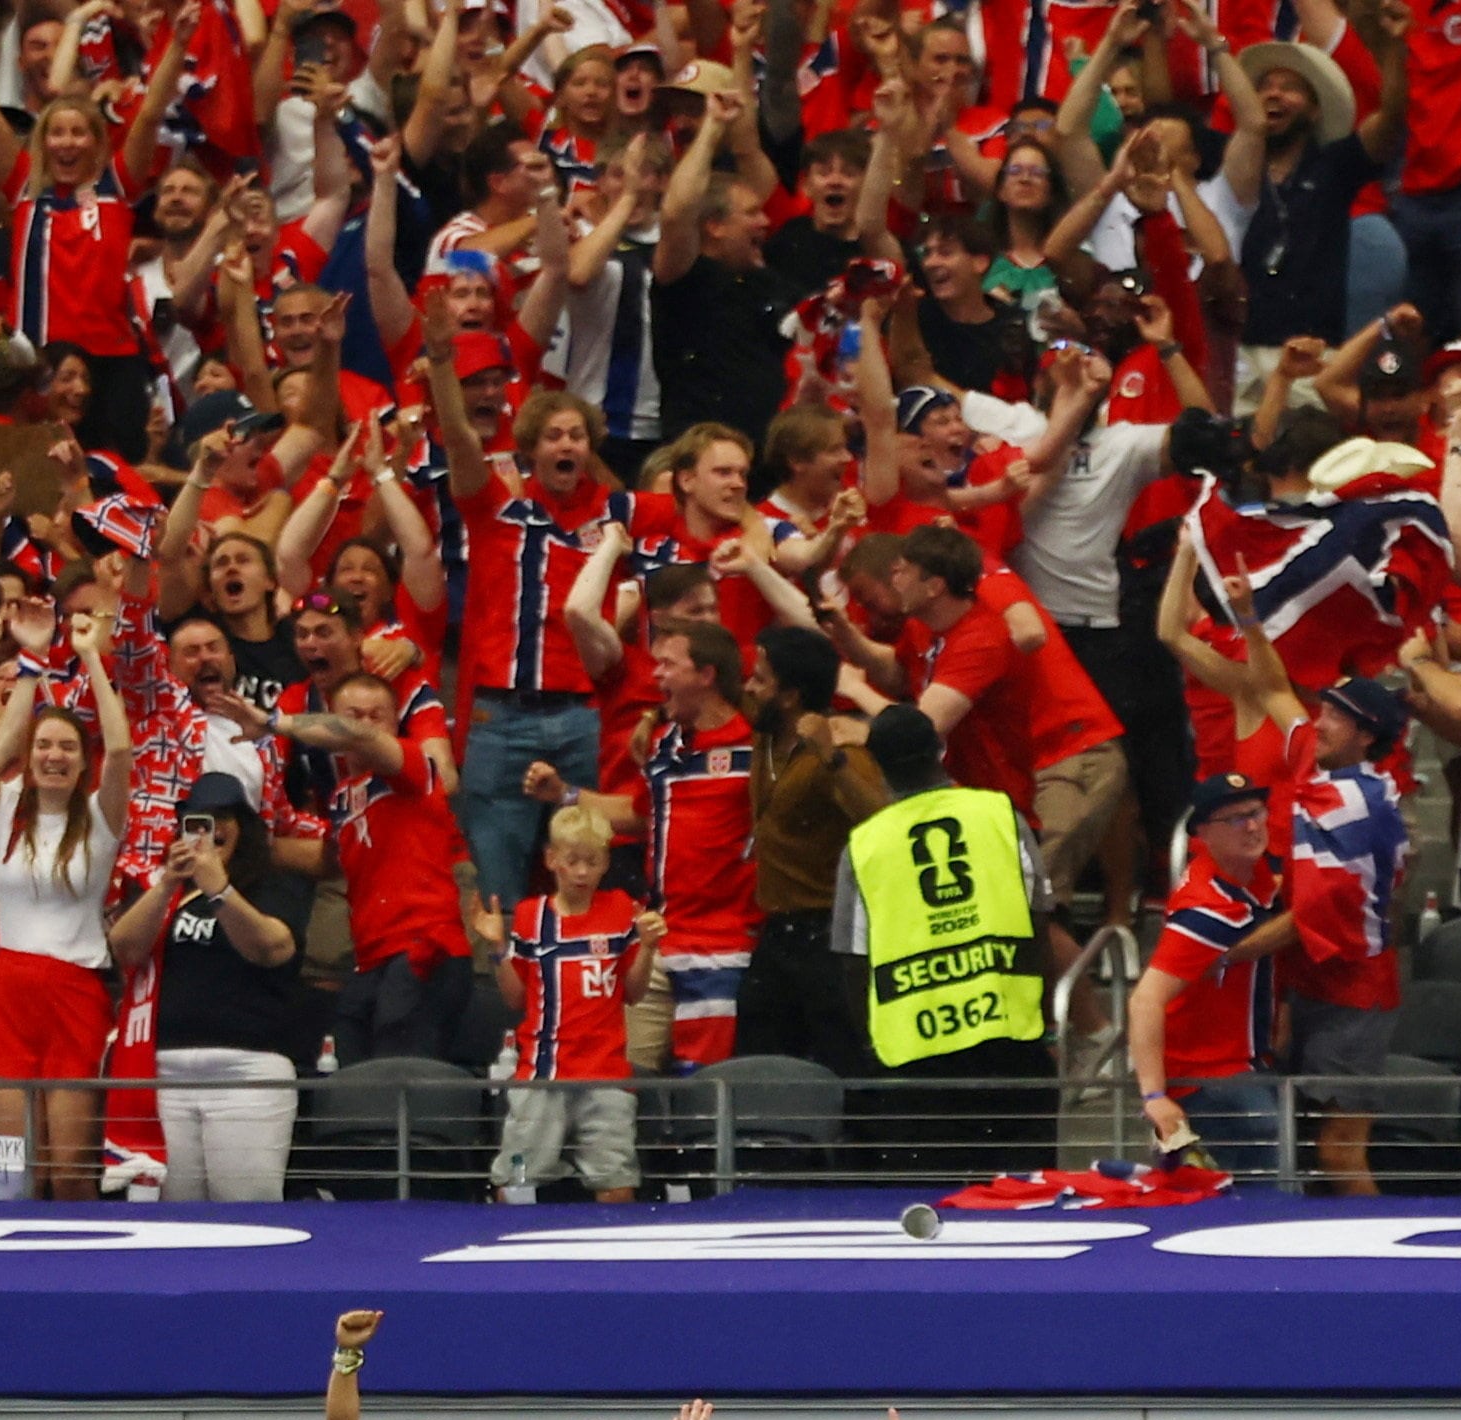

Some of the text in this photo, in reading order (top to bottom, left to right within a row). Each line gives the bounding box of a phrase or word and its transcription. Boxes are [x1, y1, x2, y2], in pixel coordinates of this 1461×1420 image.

[930, 914, 980, 936] 2026
[581, 960, 618, 997] 26
[892, 944, 1017, 994] SECURITY
[916, 992, 1003, 1040] 0362
